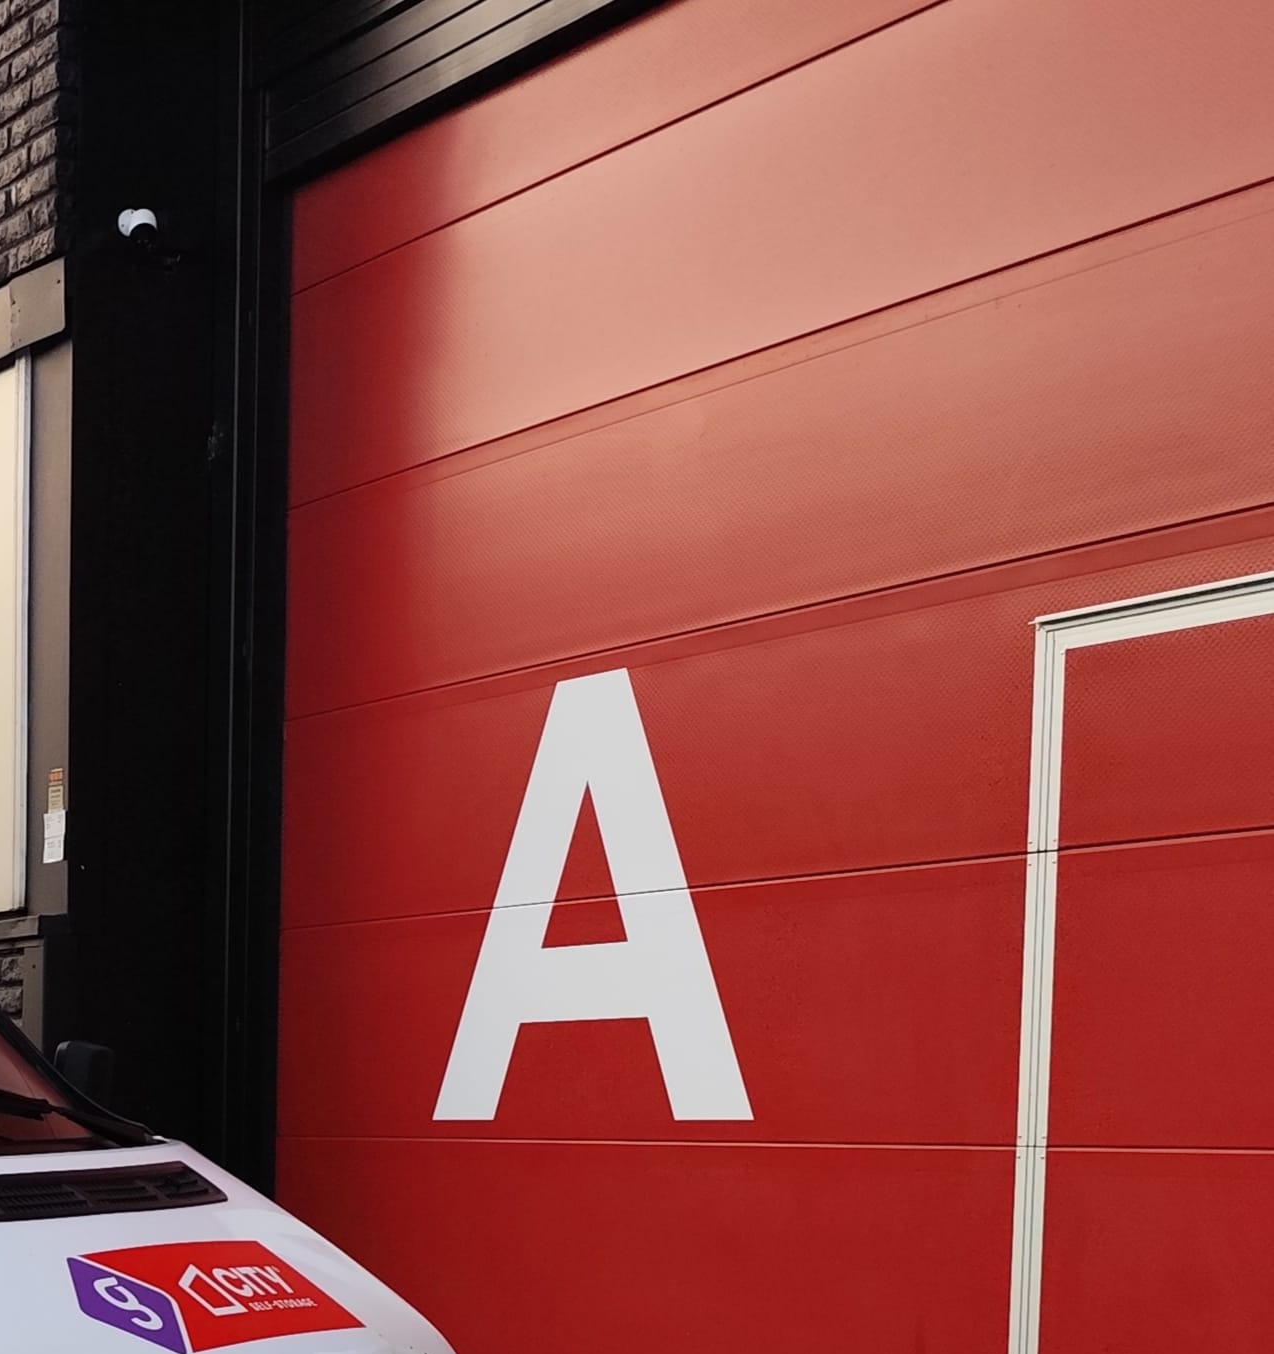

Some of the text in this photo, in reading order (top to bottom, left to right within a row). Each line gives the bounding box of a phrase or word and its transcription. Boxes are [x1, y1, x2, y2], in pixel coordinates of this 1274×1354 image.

[432, 667, 754, 1120] A
[211, 1265, 294, 1298] CITY
[248, 1297, 318, 1313] SELF-STORAGE
